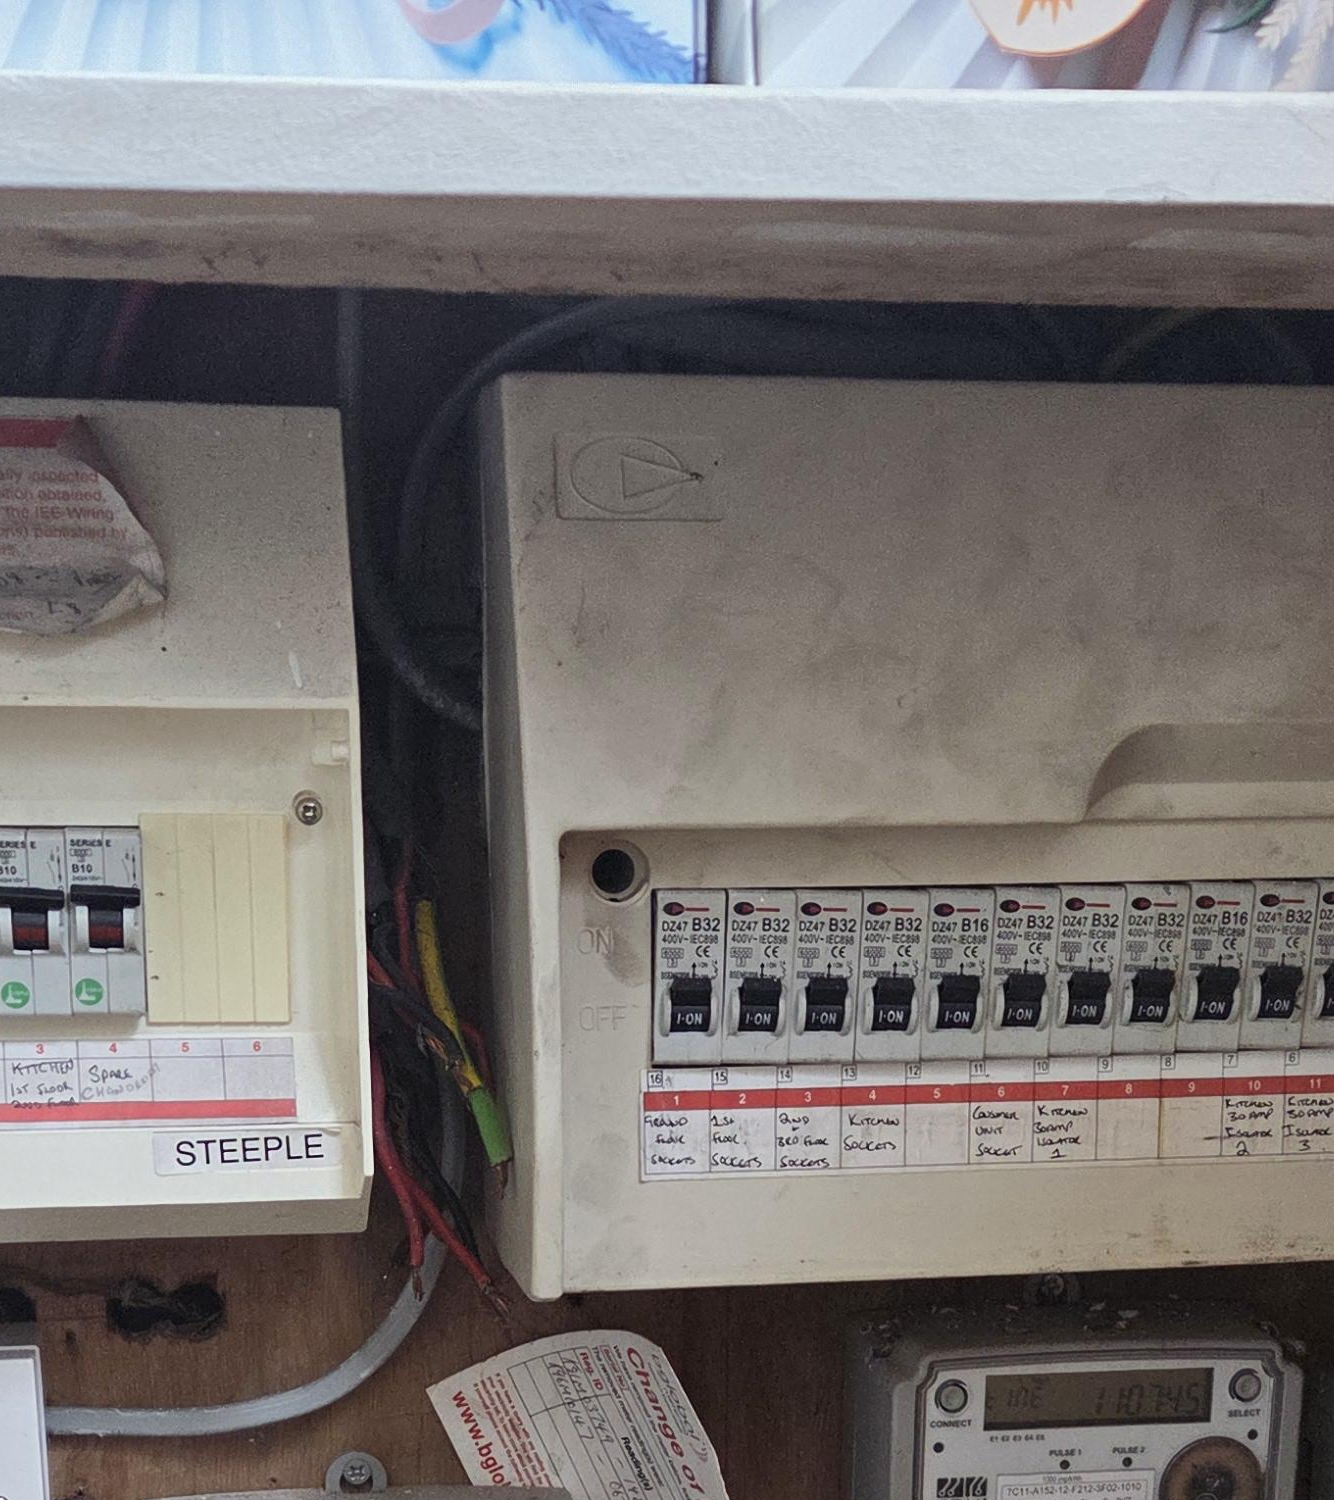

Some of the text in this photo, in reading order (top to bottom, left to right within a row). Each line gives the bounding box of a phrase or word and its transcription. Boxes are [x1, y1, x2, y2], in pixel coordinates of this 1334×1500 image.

[72, 864, 93, 873] B10
[1027, 916, 1054, 930] B32
[1092, 914, 1119, 927] B32
[1157, 914, 1185, 927] B32
[1221, 912, 1248, 926] B16
[1286, 910, 1312, 924] B32
[662, 918, 720, 932] DZ47 B32
[732, 918, 789, 932] DZ47 B32
[799, 918, 857, 932] DZ47 B32
[865, 918, 922, 932] DZ47 B32
[932, 919, 989, 932] DZ47 B16
[578, 928, 614, 955] ON
[579, 1005, 627, 1031] OFF
[175, 1133, 324, 1167] STEEPLE
[579, 1351, 604, 1391] Reg. ID
[625, 1346, 685, 1458] Change
[682, 1465, 705, 1493] of
[1228, 1408, 1261, 1418] SELECT
[930, 1420, 971, 1428] CONNECT
[621, 1435, 654, 1492] Reading(s)
